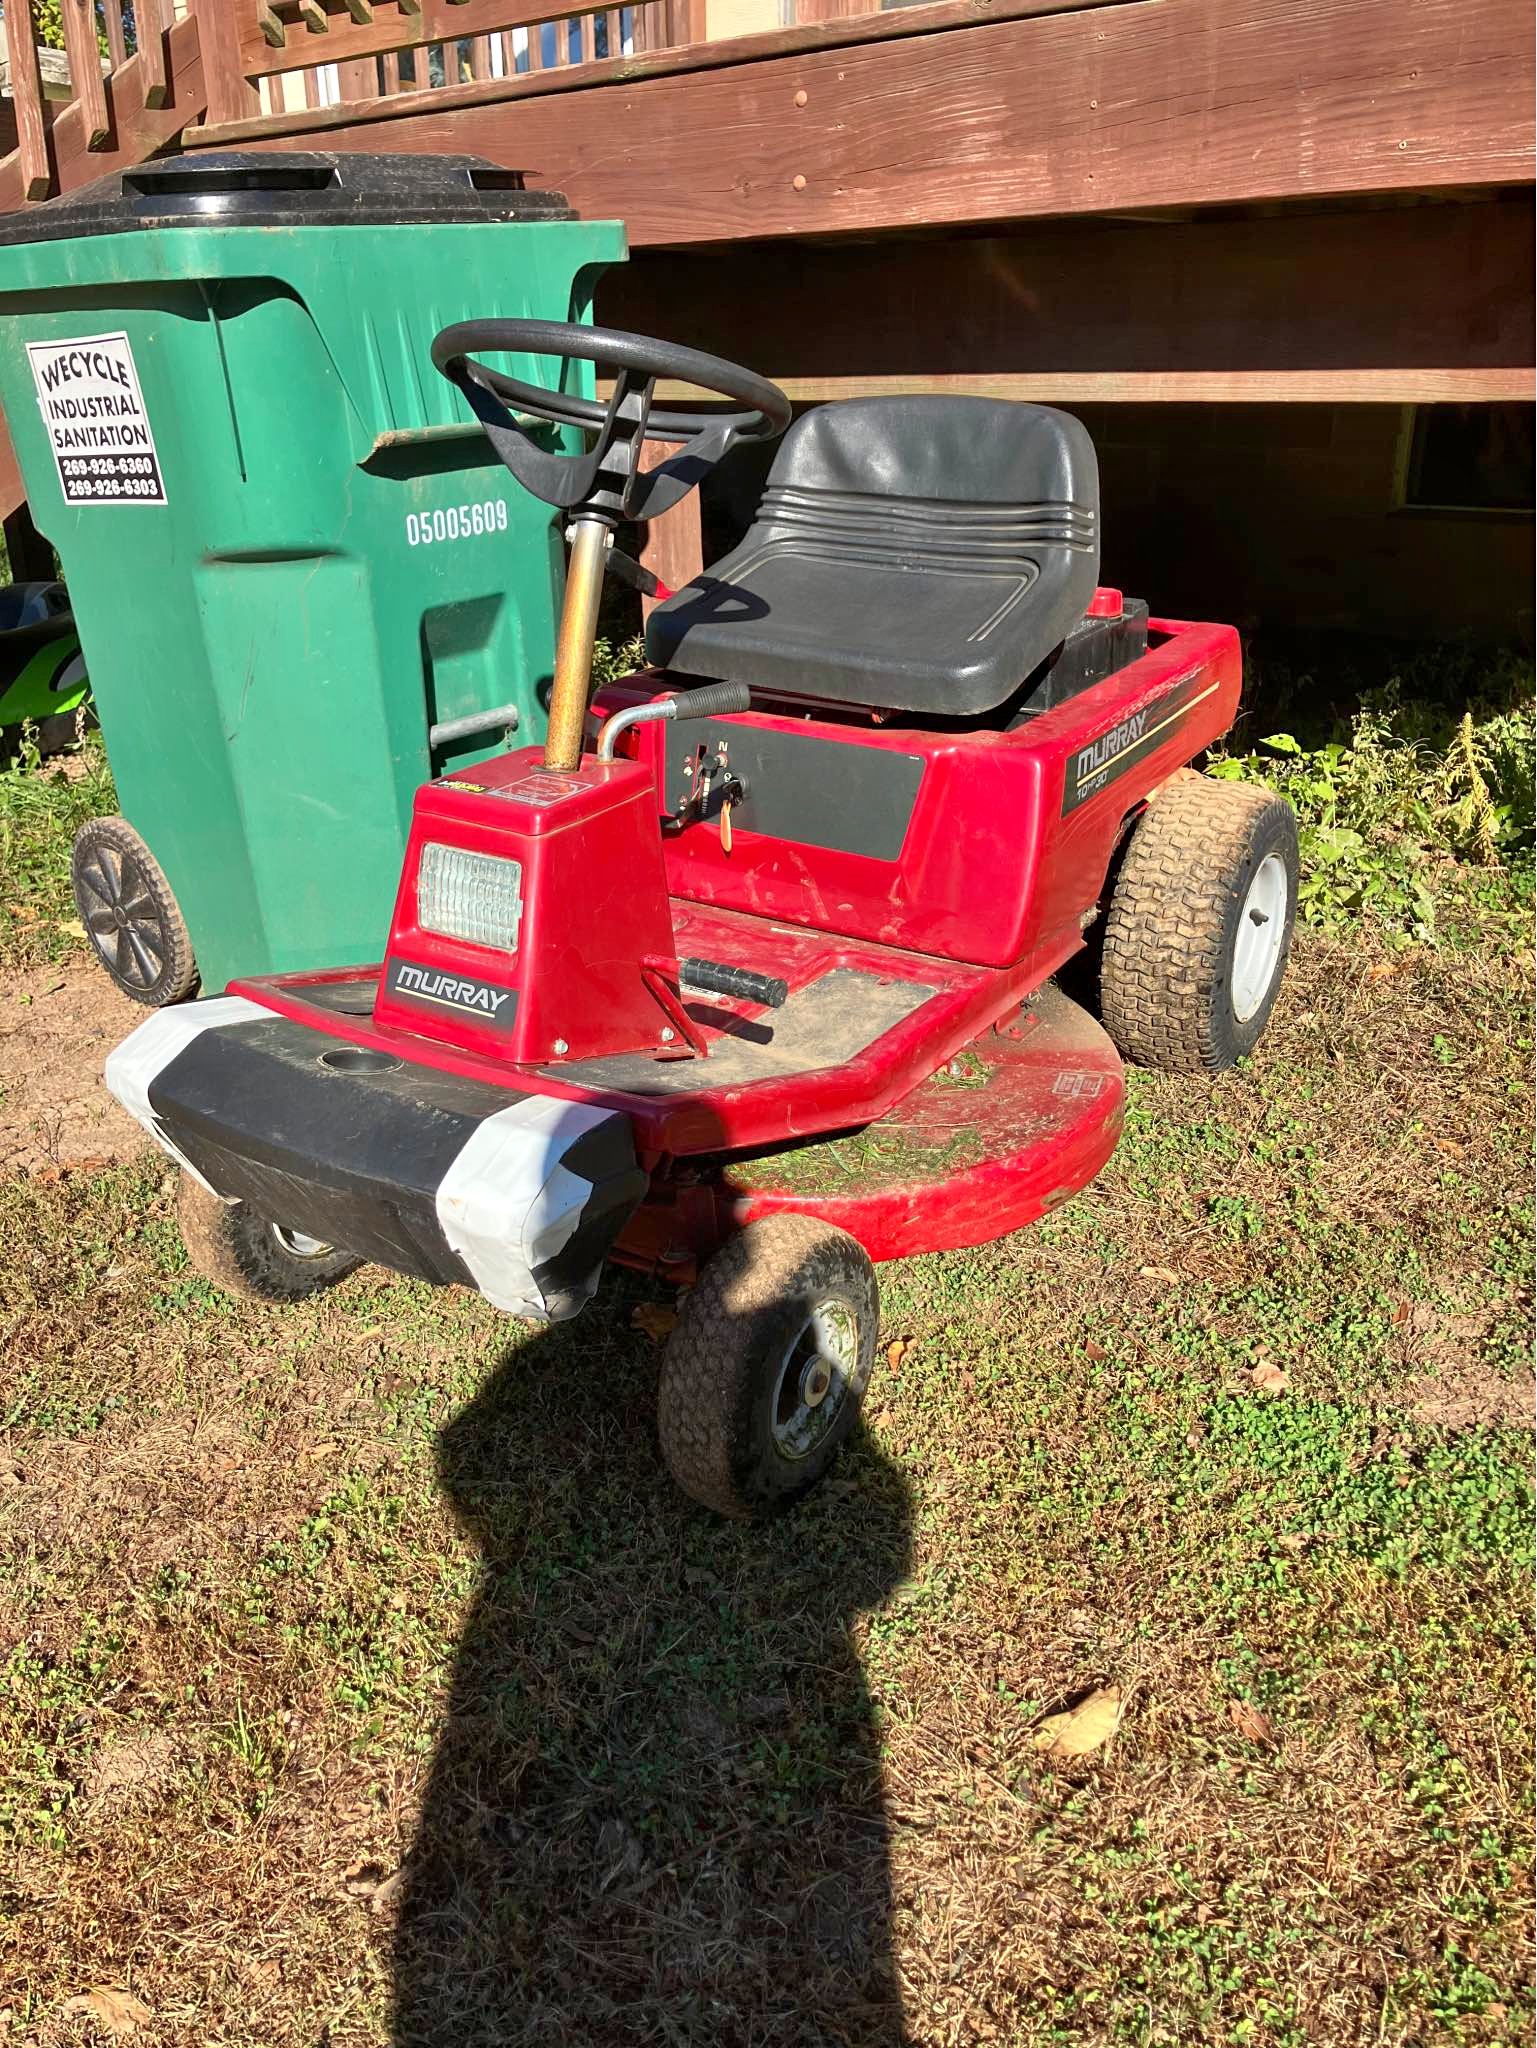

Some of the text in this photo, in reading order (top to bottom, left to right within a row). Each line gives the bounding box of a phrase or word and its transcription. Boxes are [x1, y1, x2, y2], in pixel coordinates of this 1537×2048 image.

[41, 351, 131, 392] WECYCLE
[48, 394, 140, 420] INDUSTRIAL
[54, 424, 148, 448] SANITATION
[62, 457, 153, 476] 269-926-6360
[67, 479, 158, 496] 269-926-6303
[406, 499, 508, 546] 05005609
[718, 741, 728, 752] N
[1077, 710, 1147, 779] MURRAY
[396, 965, 510, 1011] MURRAY
